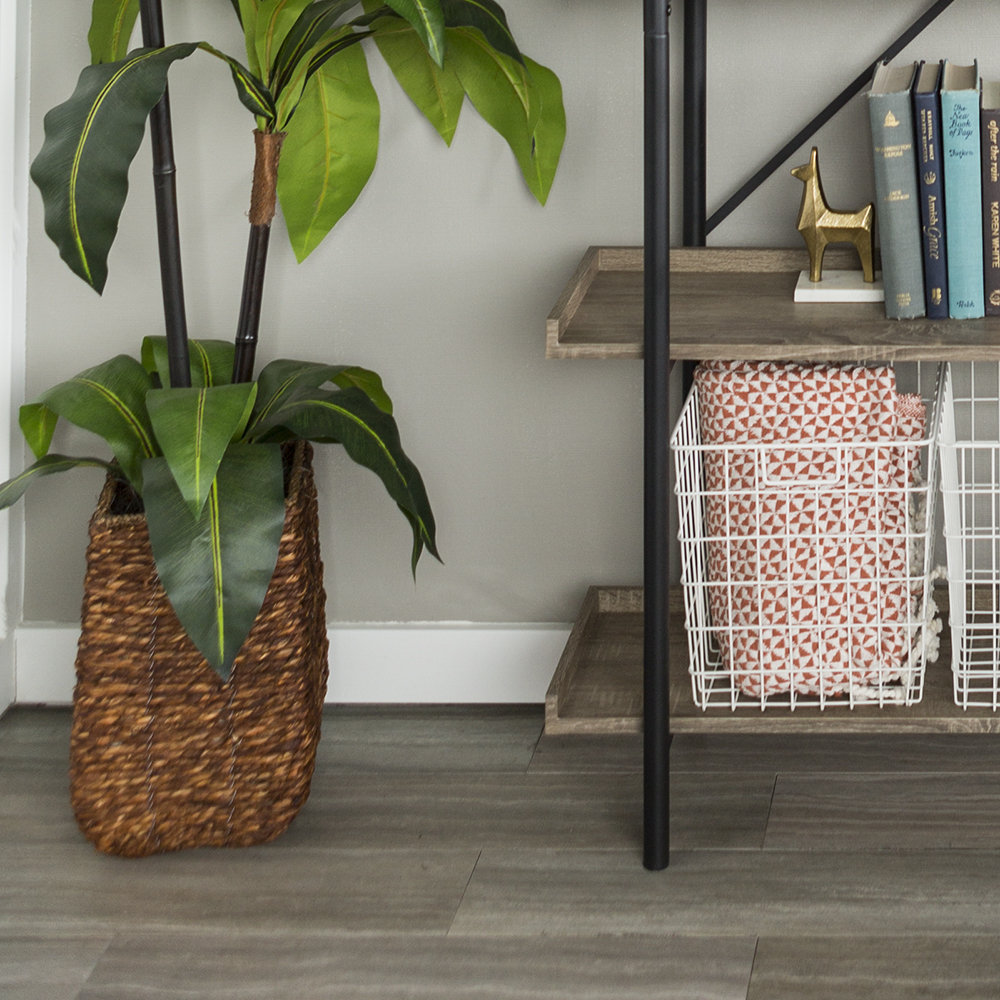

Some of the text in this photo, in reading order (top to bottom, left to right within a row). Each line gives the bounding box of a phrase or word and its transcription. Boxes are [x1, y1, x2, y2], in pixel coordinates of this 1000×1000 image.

[949, 120, 971, 128] Book
[950, 112, 969, 120] New
[988, 120, 999, 182] after the rain
[923, 195, 941, 260] Amish Grace
[991, 201, 1000, 268] KAREN WHITE
